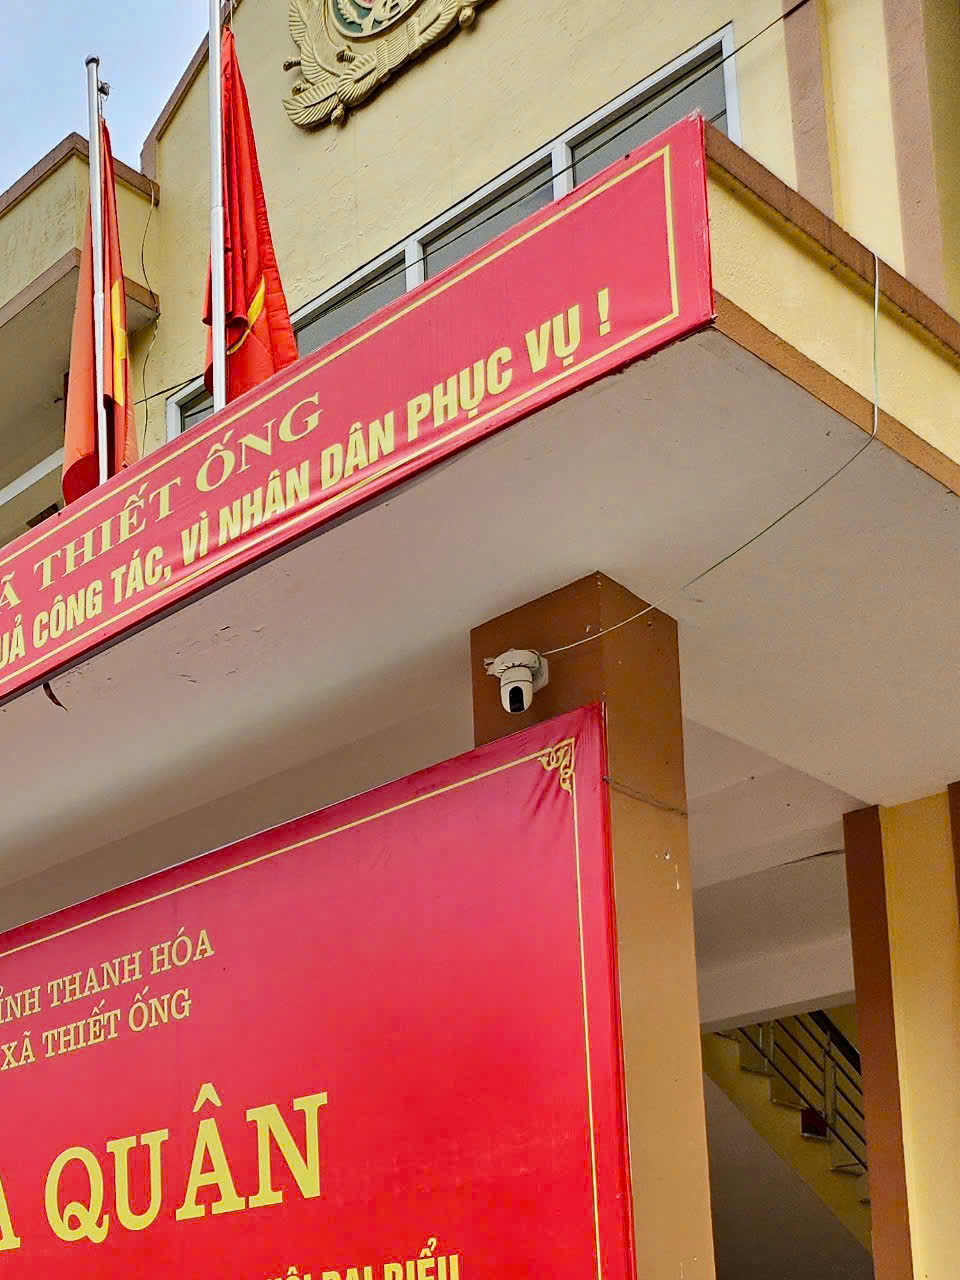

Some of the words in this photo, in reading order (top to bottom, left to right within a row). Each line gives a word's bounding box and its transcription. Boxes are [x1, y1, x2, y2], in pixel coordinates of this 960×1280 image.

[33, 580, 102, 649] CÔNG
[111, 545, 171, 601] TÁC,
[181, 512, 208, 563] VÌ
[218, 460, 309, 545] NHÂN
[320, 409, 394, 491] DÂN
[407, 346, 513, 442] PHỤC
[525, 304, 581, 373] VỤ
[34, 480, 181, 591] THIẾT
[196, 392, 324, 493] ỐNG
[1, 1031, 36, 1069] XÃ
[42, 1000, 121, 1057] THIẾT
[129, 986, 192, 1033] ỐNG
[47, 951, 142, 1008] THANH
[150, 927, 215, 975] HÓA
[45, 1082, 328, 1244] QUÂN
